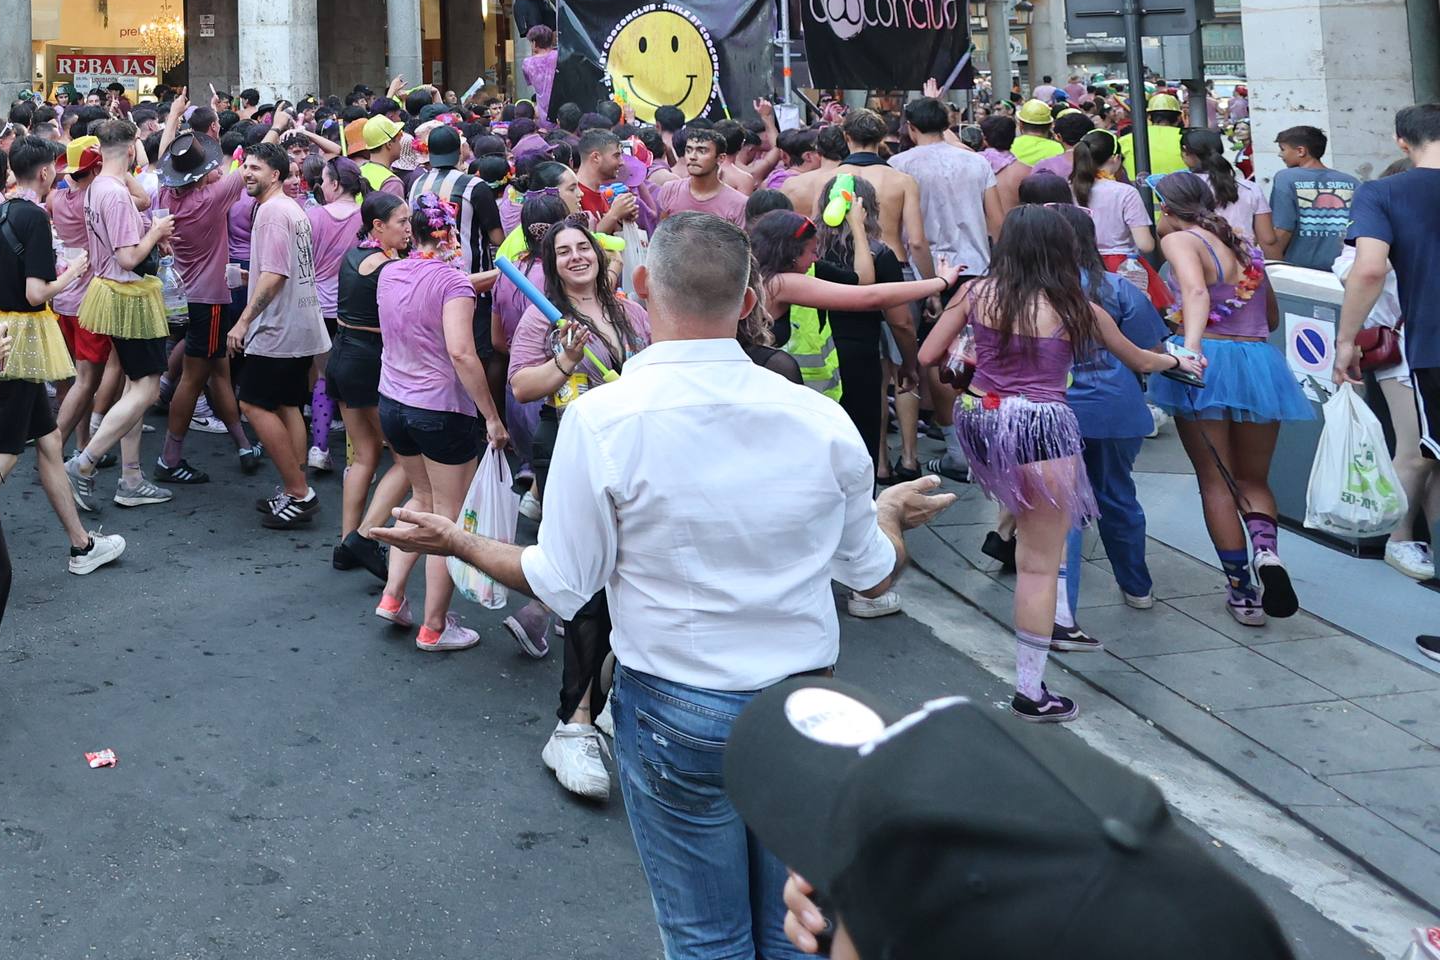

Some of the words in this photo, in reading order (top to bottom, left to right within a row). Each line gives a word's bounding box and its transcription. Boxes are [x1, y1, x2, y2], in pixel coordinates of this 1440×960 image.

[662, 3, 691, 18] SMILE
[690, 14, 703, 27] BY
[599, 51, 607, 64] BY
[603, 3, 656, 50] COOCONCLUB
[57, 58, 155, 76] REBAJAS
[1294, 181, 1316, 189] SURF
[1341, 491, 1379, 512] 50-70%
